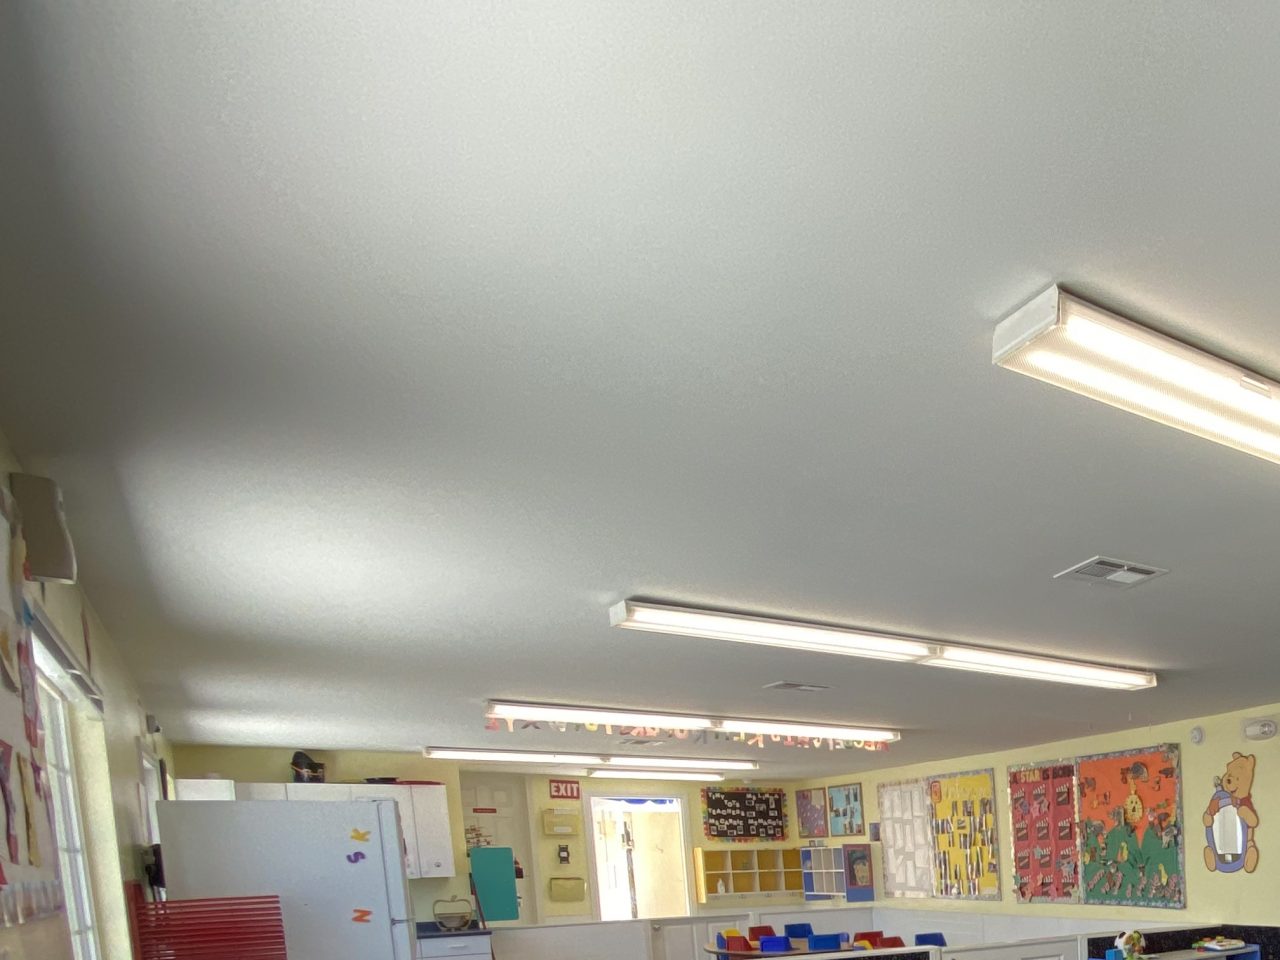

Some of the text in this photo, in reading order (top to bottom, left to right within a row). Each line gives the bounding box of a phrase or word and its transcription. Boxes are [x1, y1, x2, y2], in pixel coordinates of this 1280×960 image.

[1020, 769, 1041, 783] STAR
[551, 782, 579, 797] EXIT
[708, 792, 725, 800] TINY
[723, 799, 740, 808] TOTS
[708, 808, 745, 816] TEACHERS
